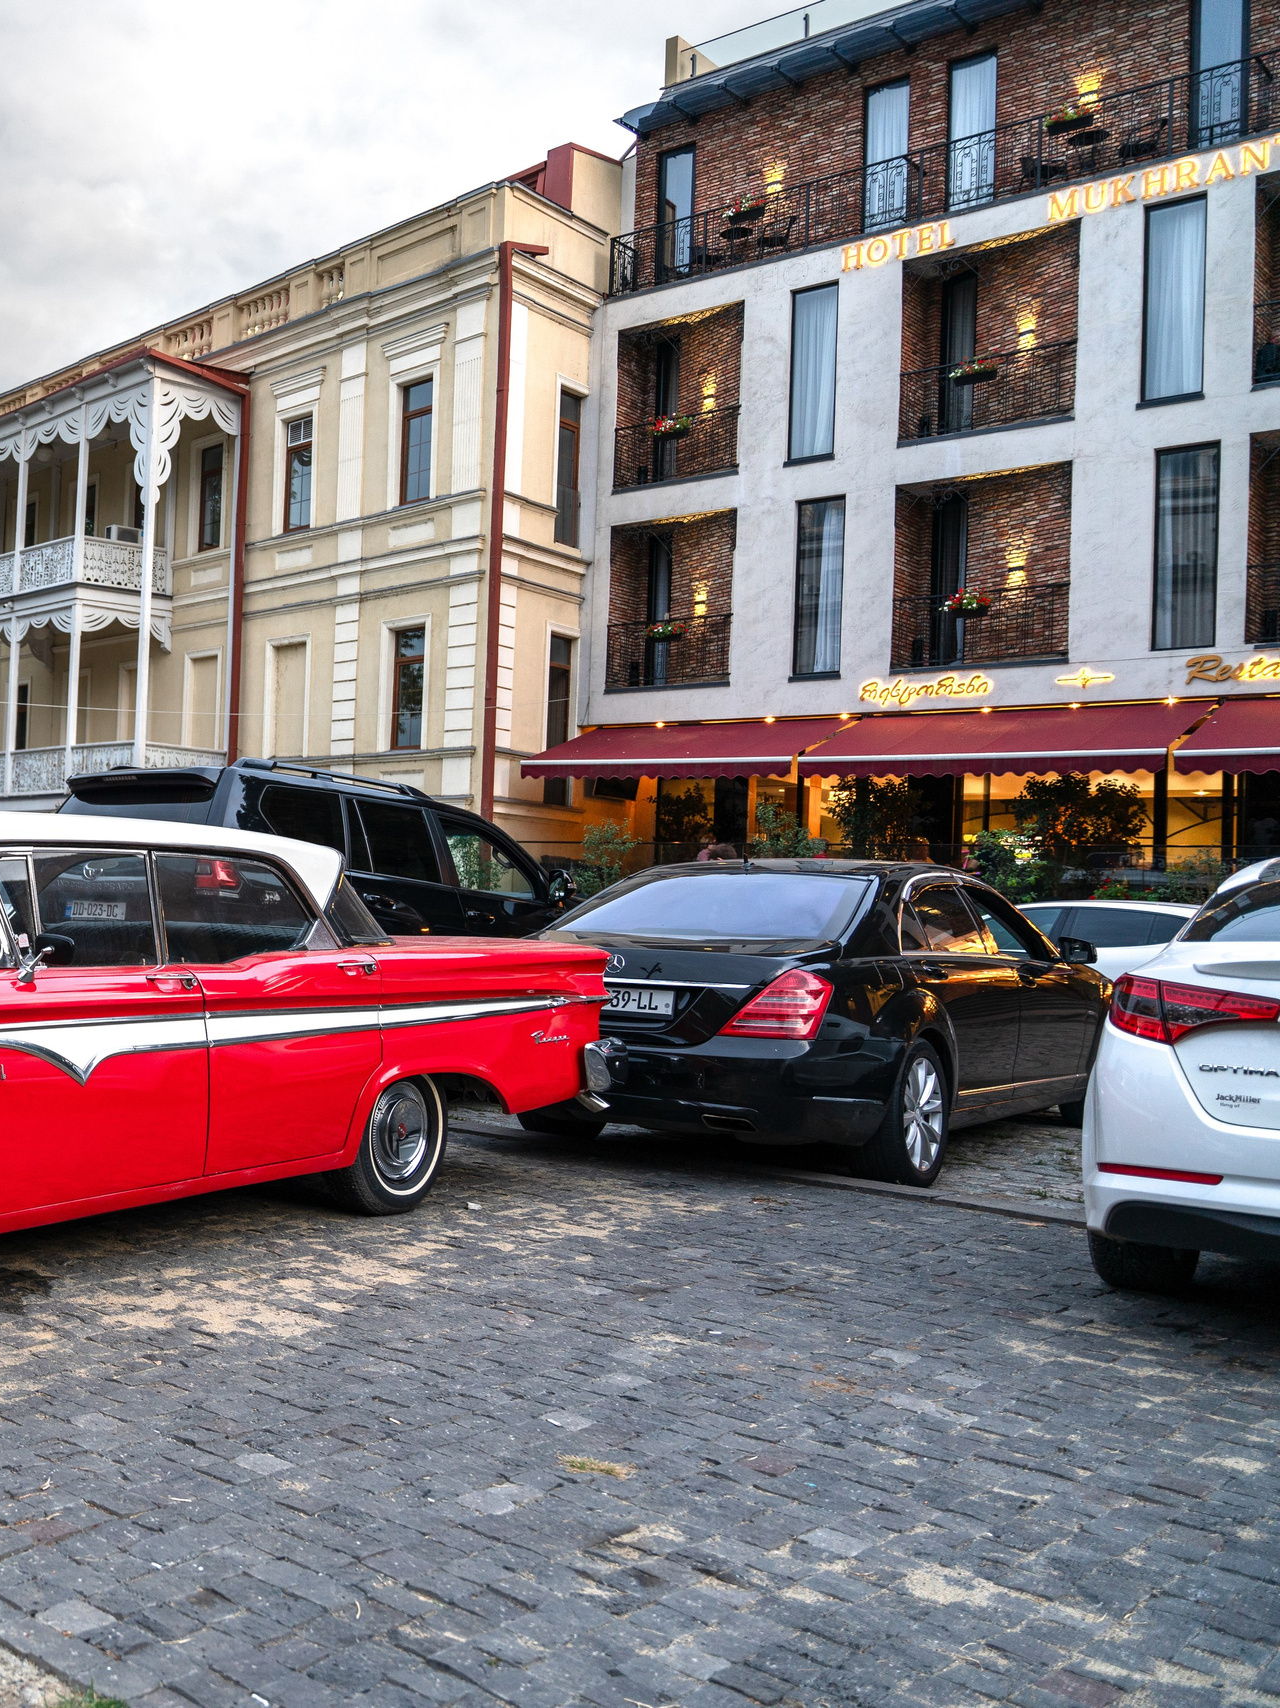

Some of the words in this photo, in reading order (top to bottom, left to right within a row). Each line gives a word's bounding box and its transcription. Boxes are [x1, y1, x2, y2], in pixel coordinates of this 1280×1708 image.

[842, 221, 956, 272] HOTEL
[1048, 133, 1280, 222] MUKHRAN
[859, 675, 989, 706] რესტორანი
[72, 902, 118, 918] DD-023-DC
[606, 989, 659, 1011] 39-LL
[1199, 1063, 1280, 1078] OPTIMA
[1215, 1093, 1261, 1104] JackMiller
